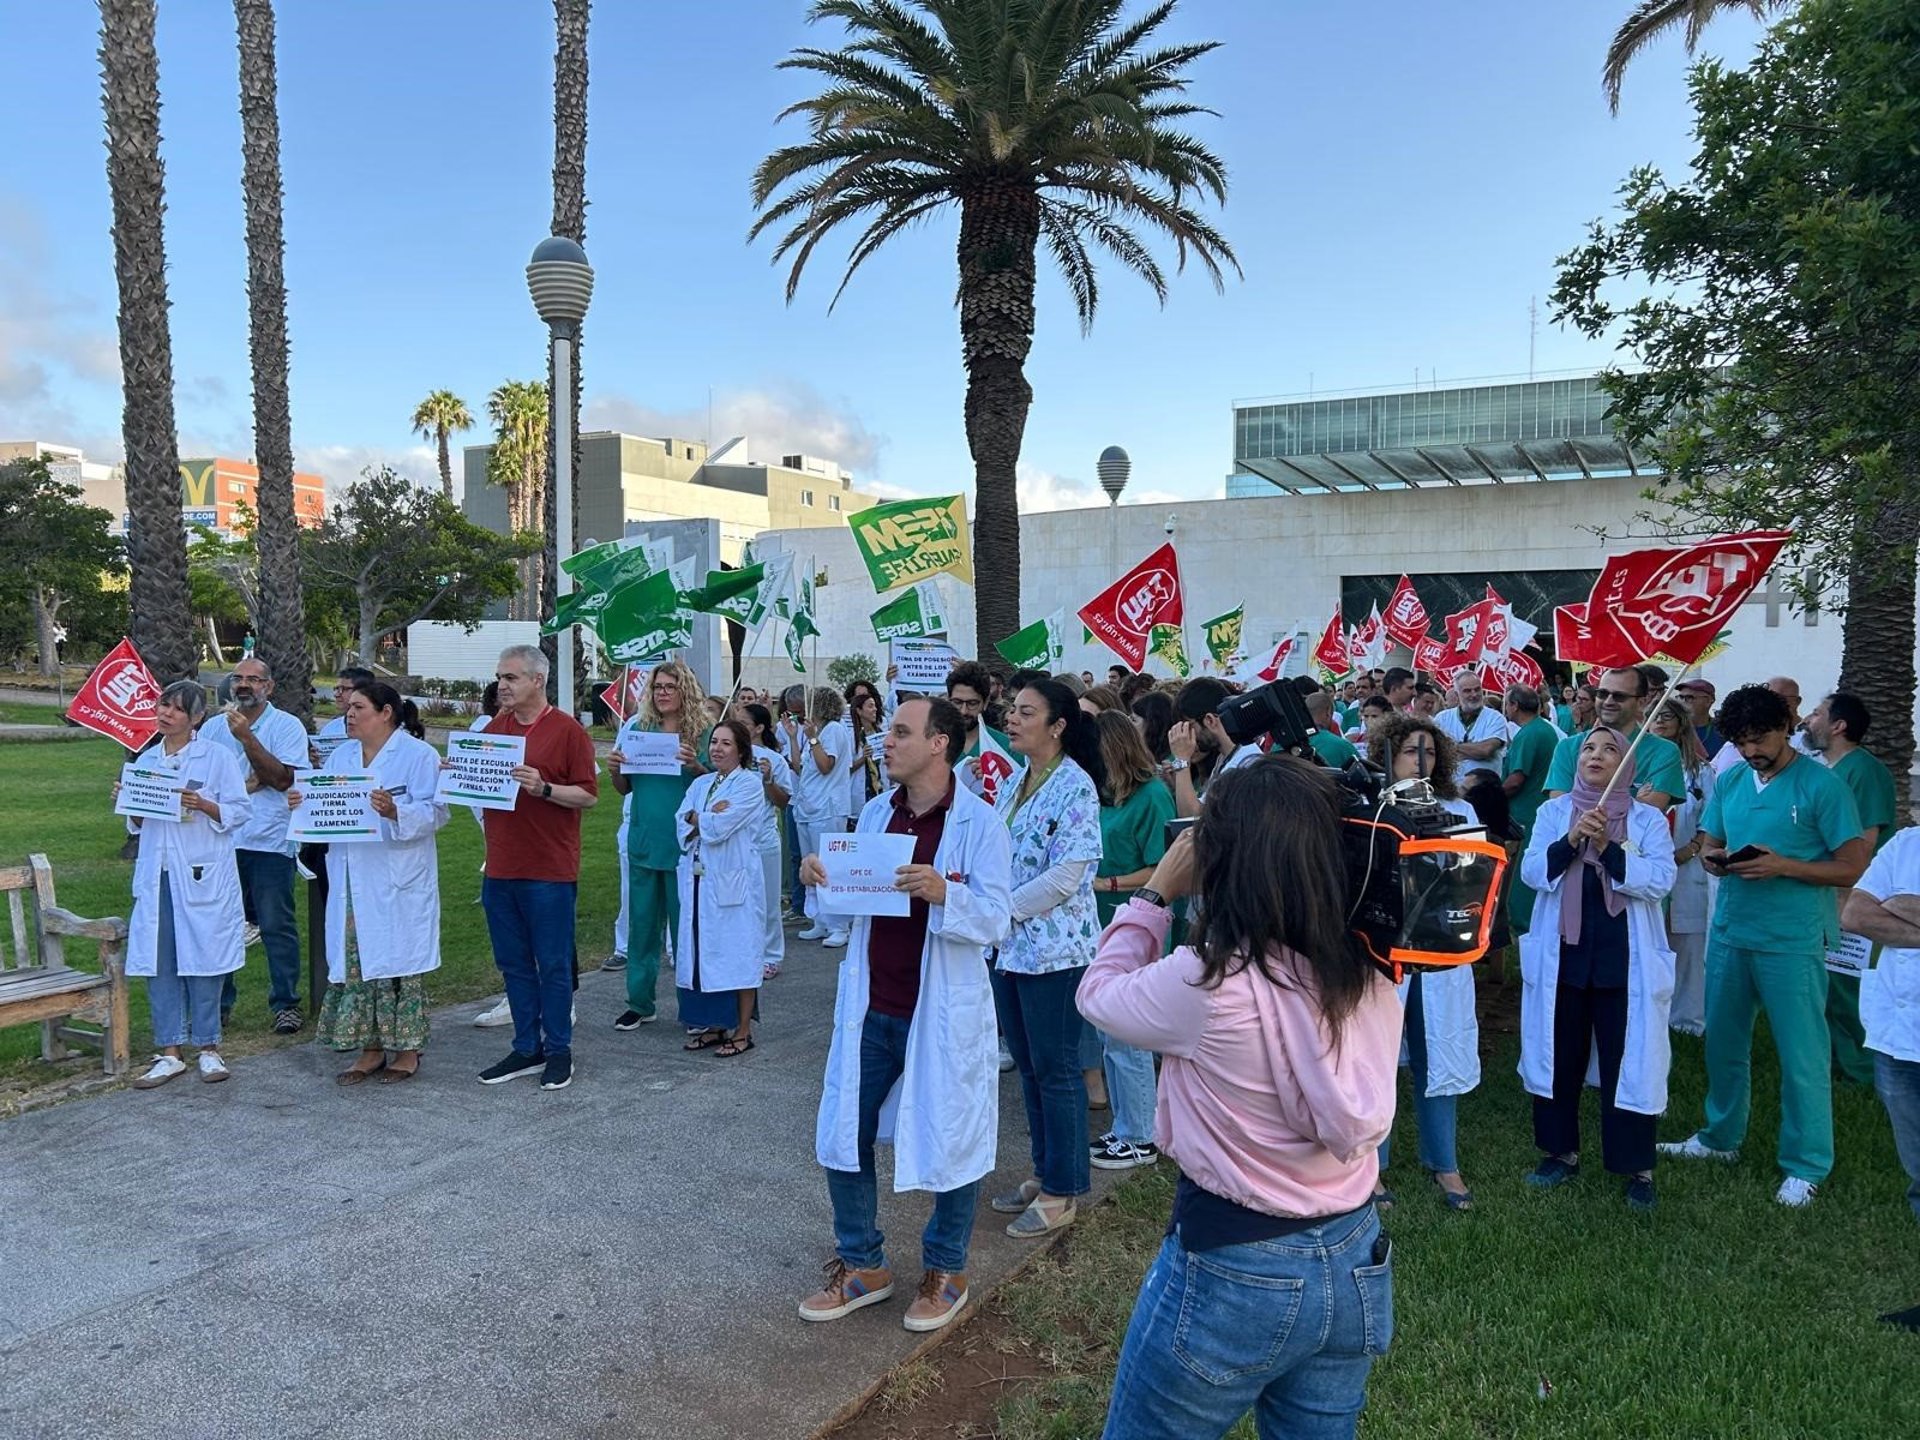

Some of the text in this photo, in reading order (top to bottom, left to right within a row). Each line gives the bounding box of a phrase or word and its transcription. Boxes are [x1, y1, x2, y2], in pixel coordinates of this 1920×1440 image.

[1121, 572, 1162, 621] UGT
[1093, 613, 1141, 660] www.ugt.es
[101, 663, 146, 707] UGT
[79, 705, 135, 739] www.ugt.es
[349, 808, 364, 816] LOS
[828, 841, 841, 852] UGT
